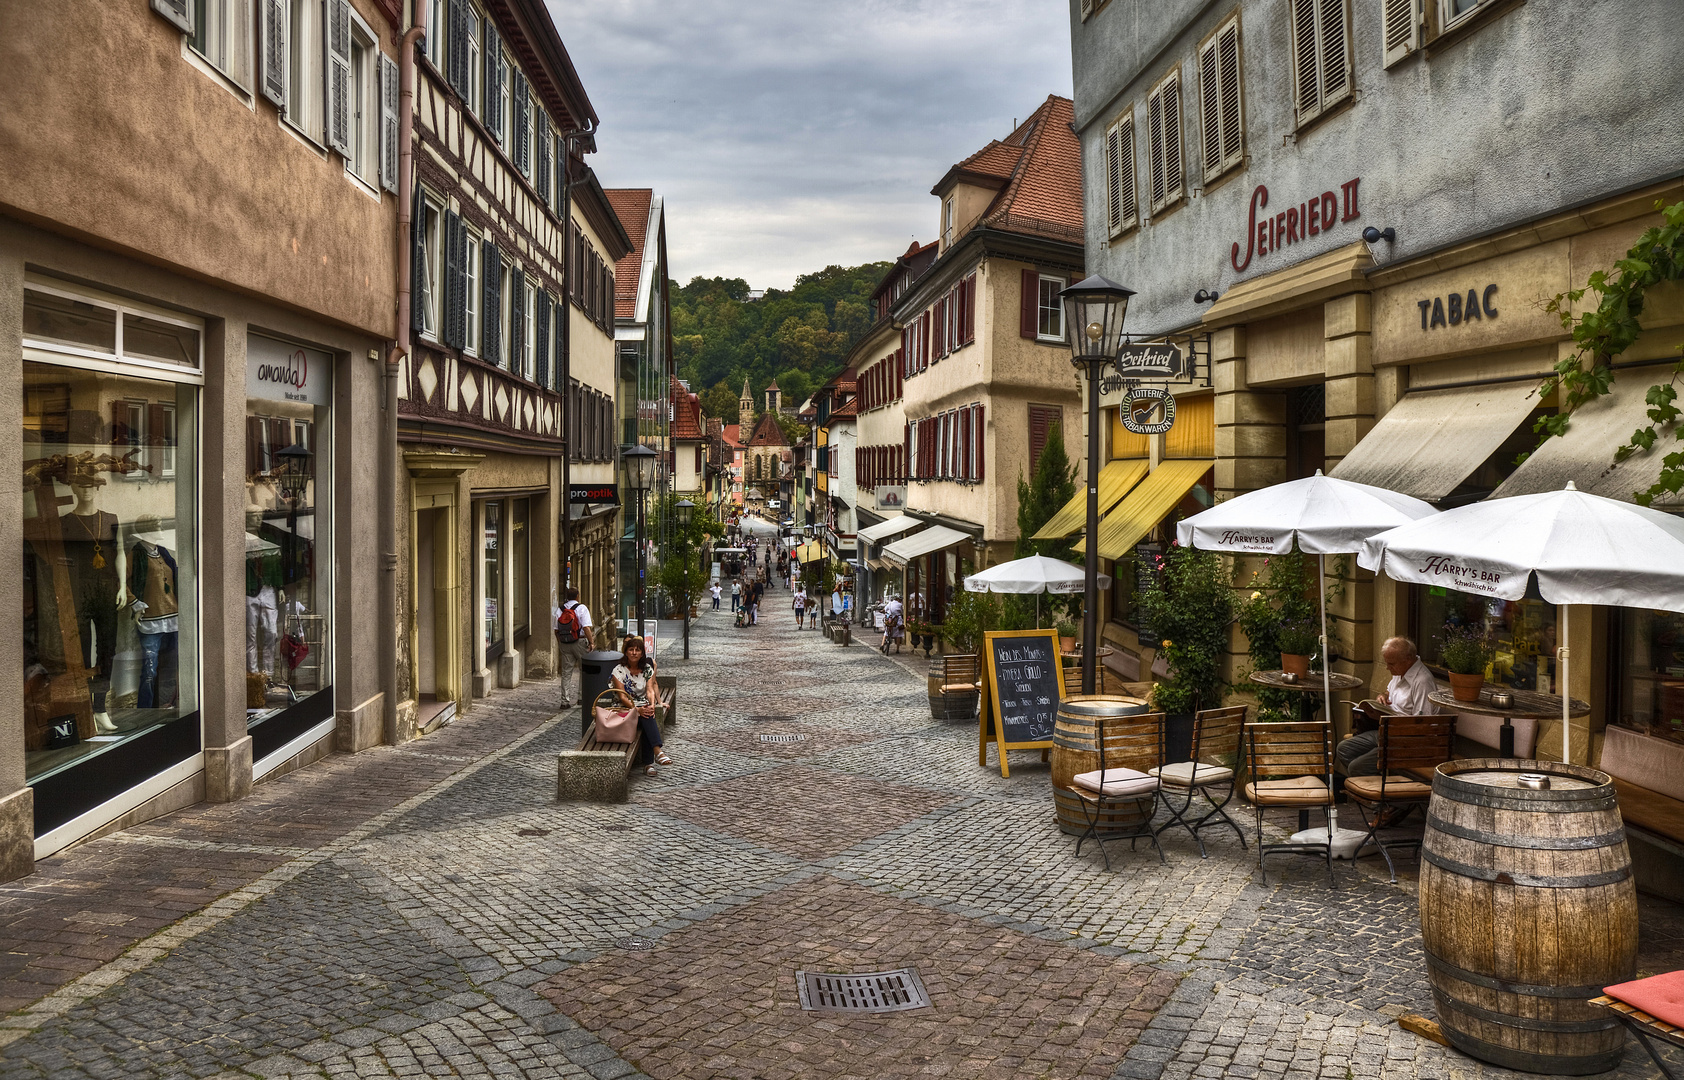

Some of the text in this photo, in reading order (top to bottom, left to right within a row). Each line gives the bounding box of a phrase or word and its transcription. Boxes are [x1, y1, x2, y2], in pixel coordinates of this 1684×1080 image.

[1231, 177, 1361, 272] SEIFRIED II
[1417, 283, 1498, 330] TABAC
[1121, 347, 1174, 368] Seifried
[1131, 389, 1164, 399] LOTTERIE
[1122, 396, 1132, 416] TOTO
[1164, 395, 1175, 418] LOTTO
[1123, 415, 1172, 434] TABAKWAREN
[1260, 536, 1275, 544] BAR
[1418, 555, 1501, 584] HARRY'S BAR
[1453, 578, 1487, 591] Schwäbisch
[54, 720, 73, 739] NÜ
